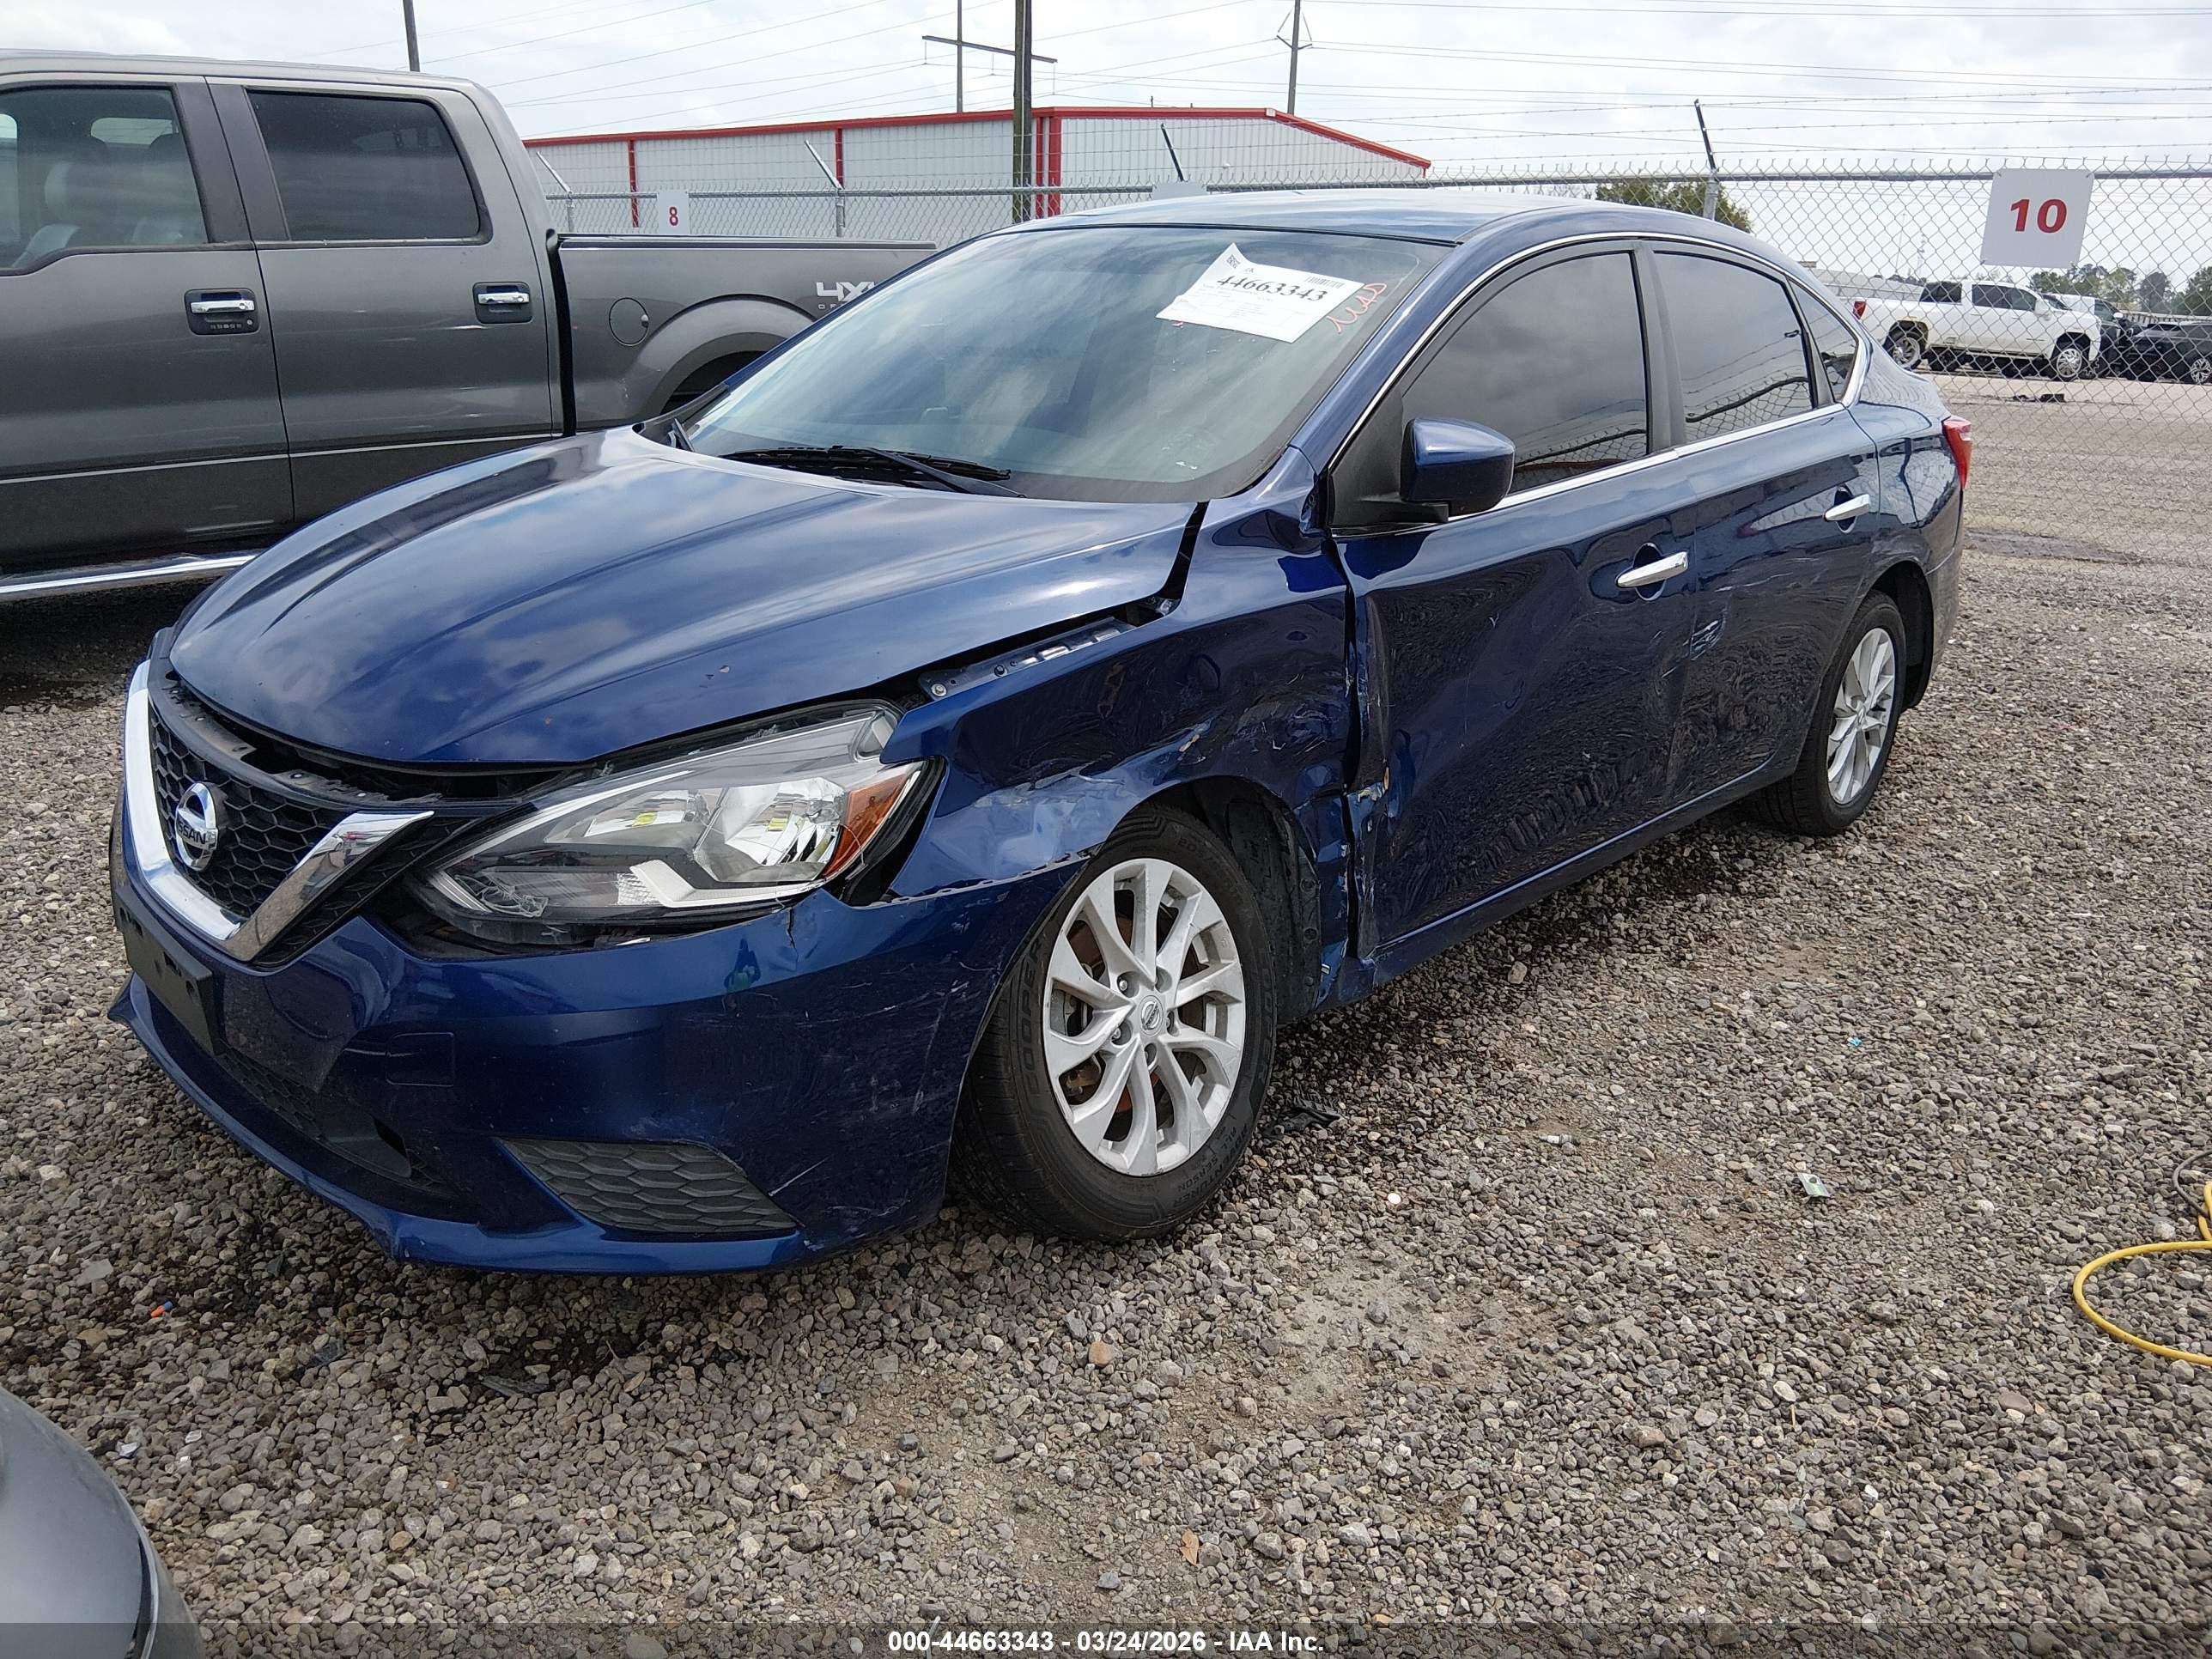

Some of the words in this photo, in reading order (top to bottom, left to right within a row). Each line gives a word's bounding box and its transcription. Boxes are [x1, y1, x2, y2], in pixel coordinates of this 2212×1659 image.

[669, 206, 678, 227] 8
[2010, 198, 2067, 234] 10
[816, 281, 875, 302] 4X
[1217, 275, 1328, 301] 44663343
